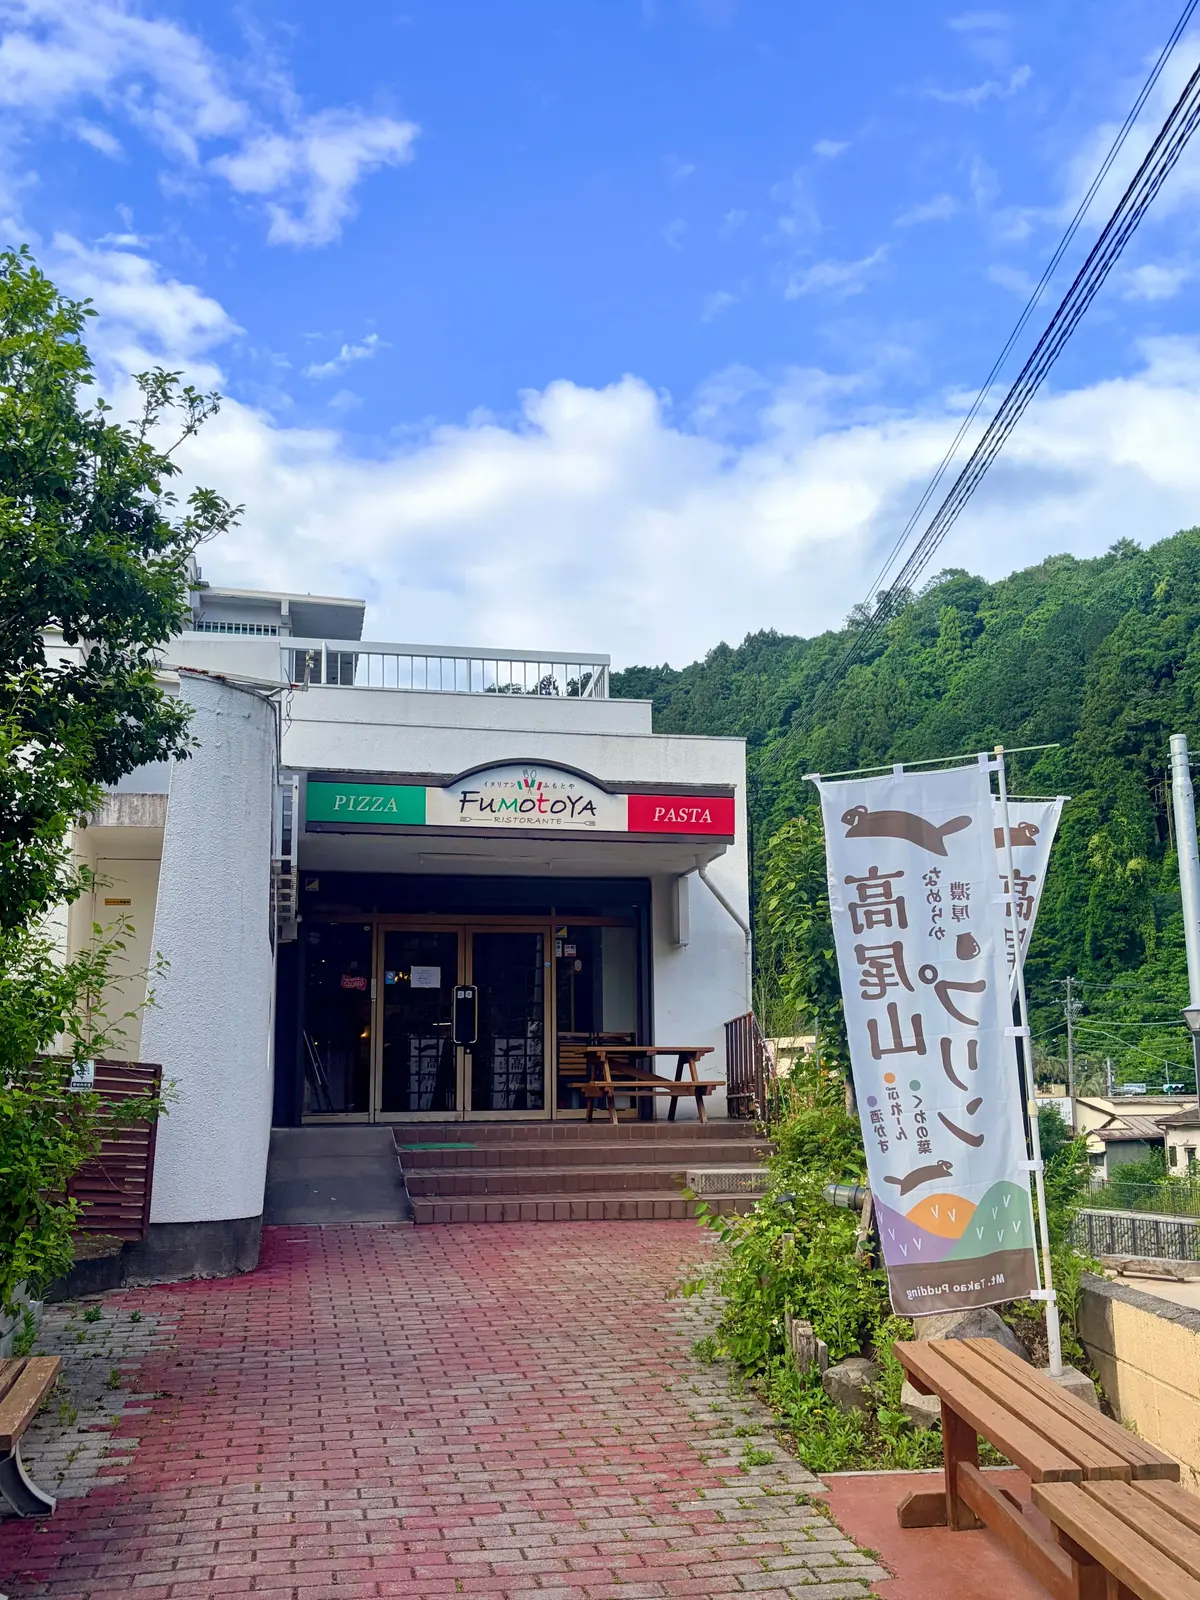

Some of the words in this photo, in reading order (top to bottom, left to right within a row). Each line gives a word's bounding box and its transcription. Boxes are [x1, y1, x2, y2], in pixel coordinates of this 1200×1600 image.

[483, 781, 516, 789] イタリアン
[543, 781, 575, 790] ふもとや
[333, 794, 398, 812] PIZZA
[493, 816, 562, 825] RISTORANTE
[653, 806, 713, 824] PASTA
